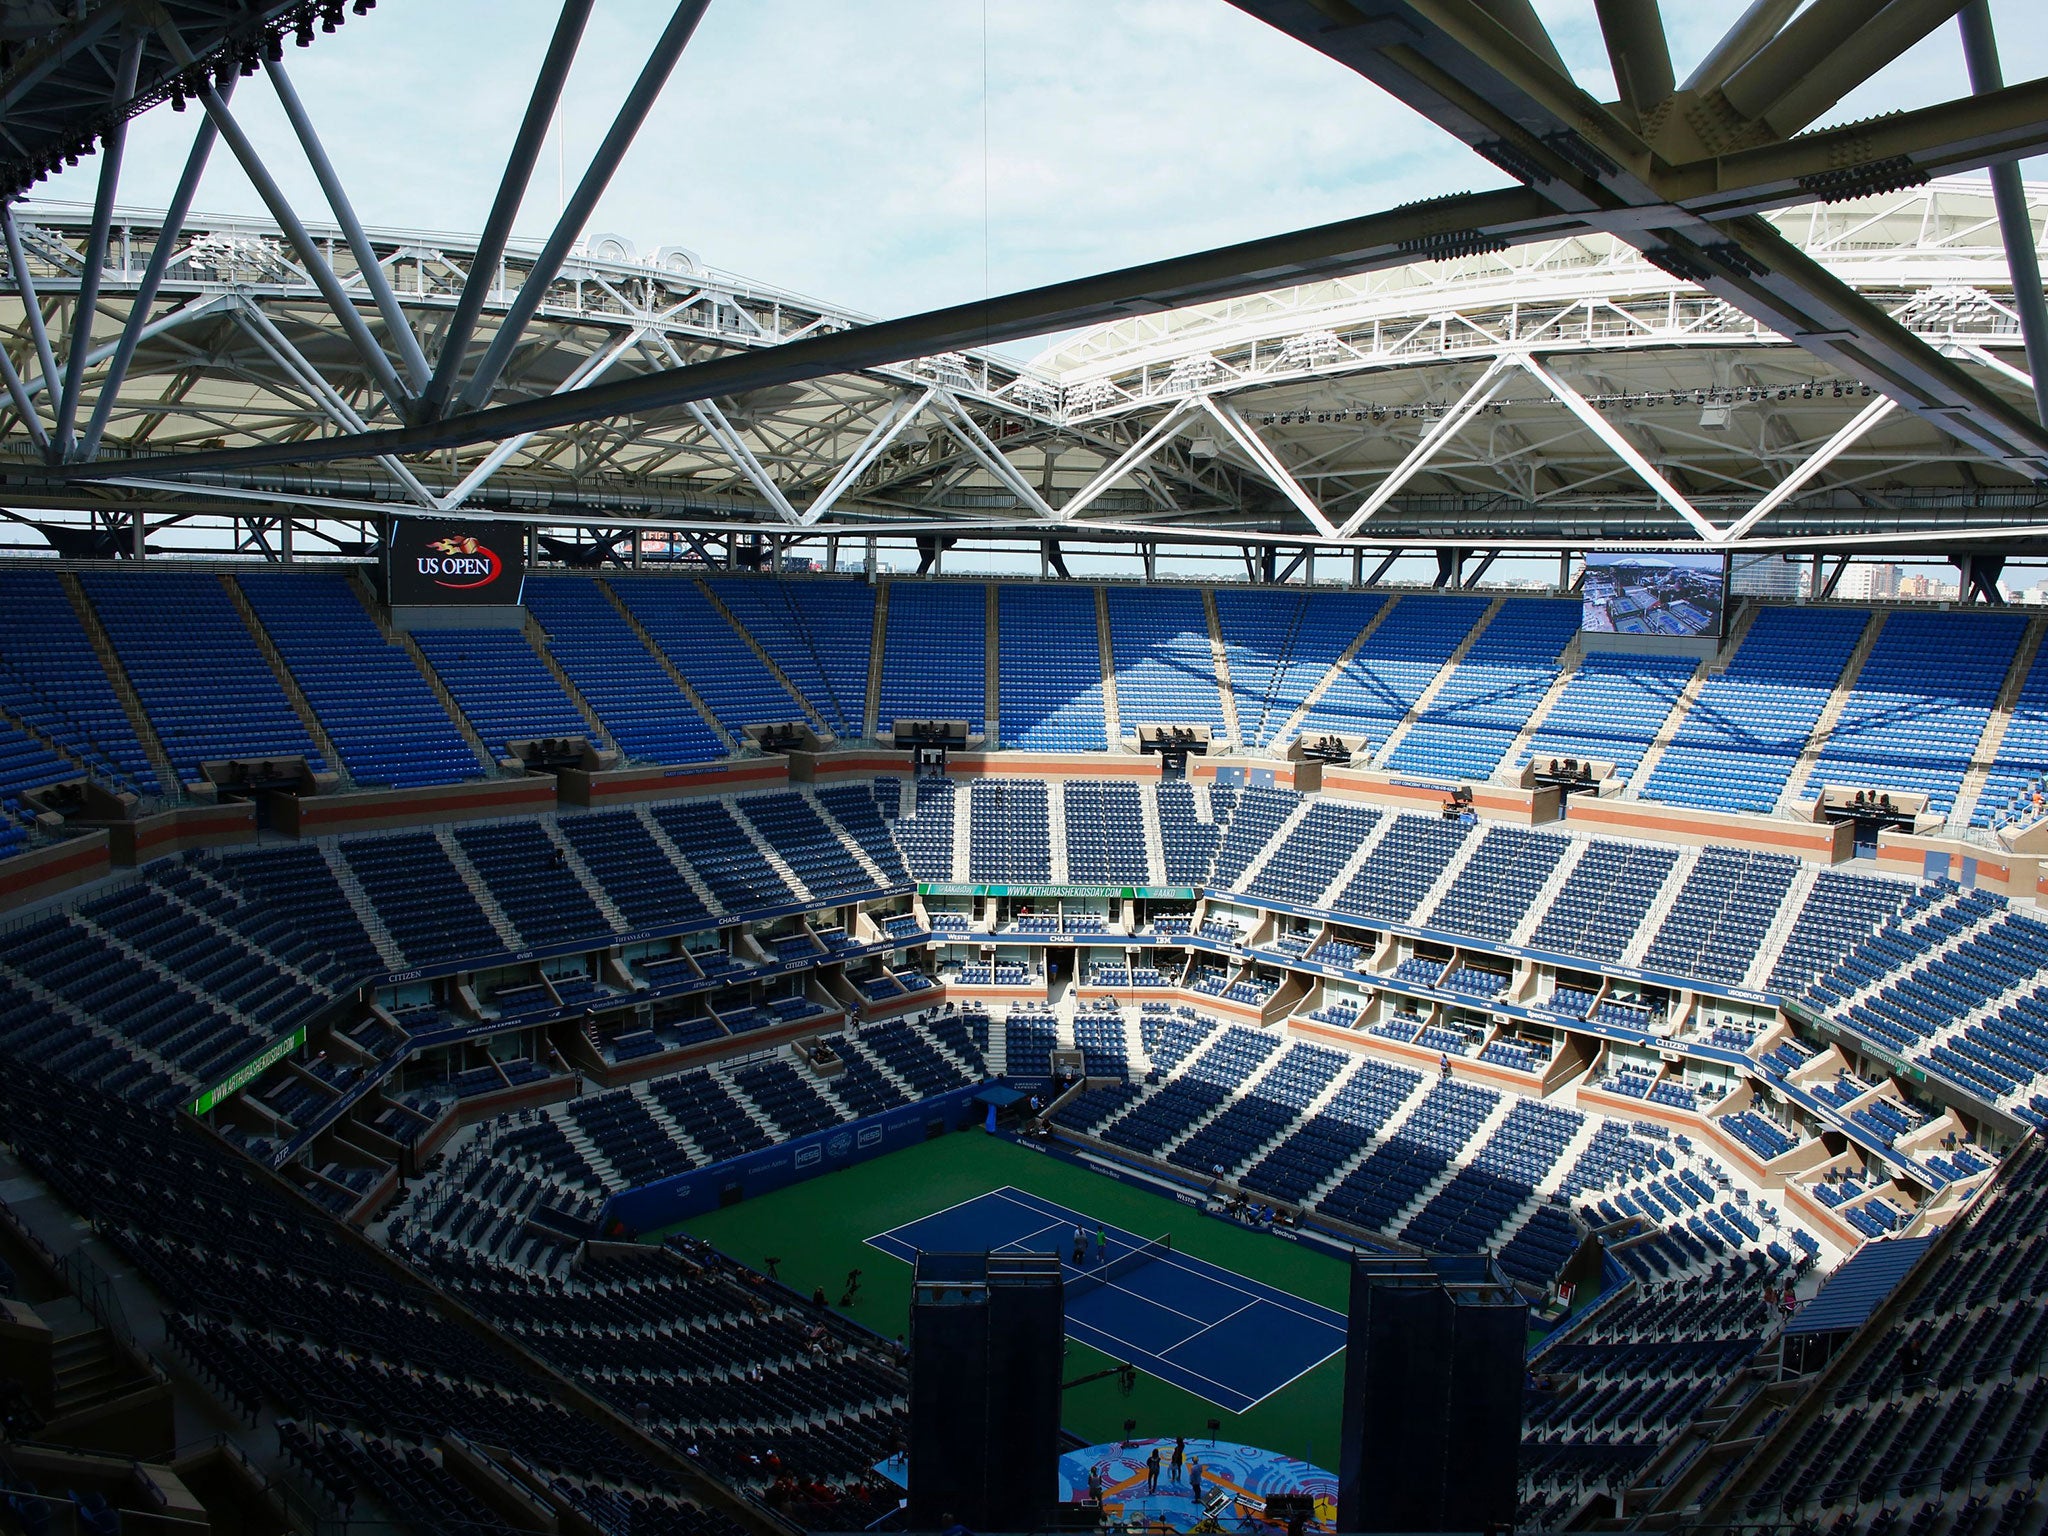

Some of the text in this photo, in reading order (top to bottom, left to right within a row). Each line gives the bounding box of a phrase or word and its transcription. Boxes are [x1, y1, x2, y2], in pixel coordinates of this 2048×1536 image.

[417, 558, 490, 576] US OPEN
[1007, 886, 1122, 898] WWW.ARTHURASHEKIDSDAY.COM
[718, 915, 741, 925] CHASE
[947, 933, 971, 941] WESTIN
[1050, 935, 1074, 943] CHASE
[1155, 936, 1172, 944] IBM
[516, 951, 533, 961] evian
[785, 959, 809, 970] CITIZEN
[388, 970, 422, 983] CITIZEN
[1727, 989, 1766, 1002] usopen.org
[1526, 1010, 1557, 1022] Spectrum
[467, 1023, 496, 1034] AMERICAN
[1655, 1038, 1689, 1052] CITIZEN
[1753, 1063, 1767, 1078] WTA
[859, 1130, 881, 1143] HESS
[273, 1146, 290, 1166] ATP
[797, 1150, 819, 1164] HESS
[1176, 1192, 1198, 1204] WESTIN
[1271, 1227, 1298, 1241] Spectrum
